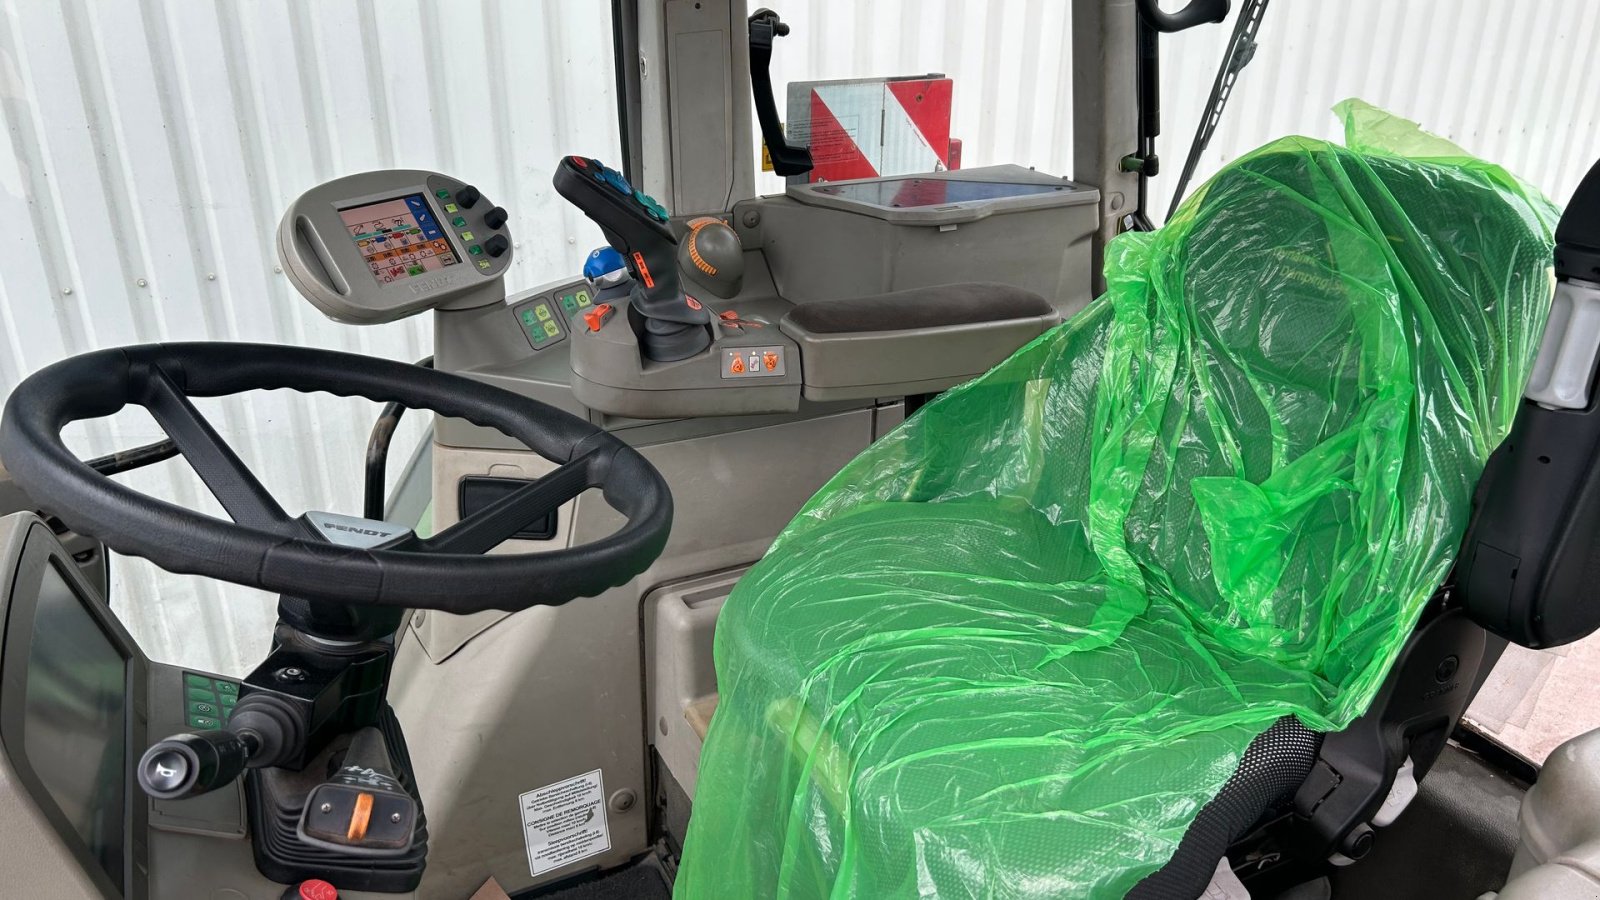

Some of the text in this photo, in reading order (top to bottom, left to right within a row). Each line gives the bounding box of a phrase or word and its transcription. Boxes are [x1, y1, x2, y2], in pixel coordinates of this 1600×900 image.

[1279, 265, 1329, 291] Damping
[323, 522, 392, 537] FENDT
[527, 814, 554, 827] CONSIGNE
[563, 798, 600, 814] REMORQUAGE
